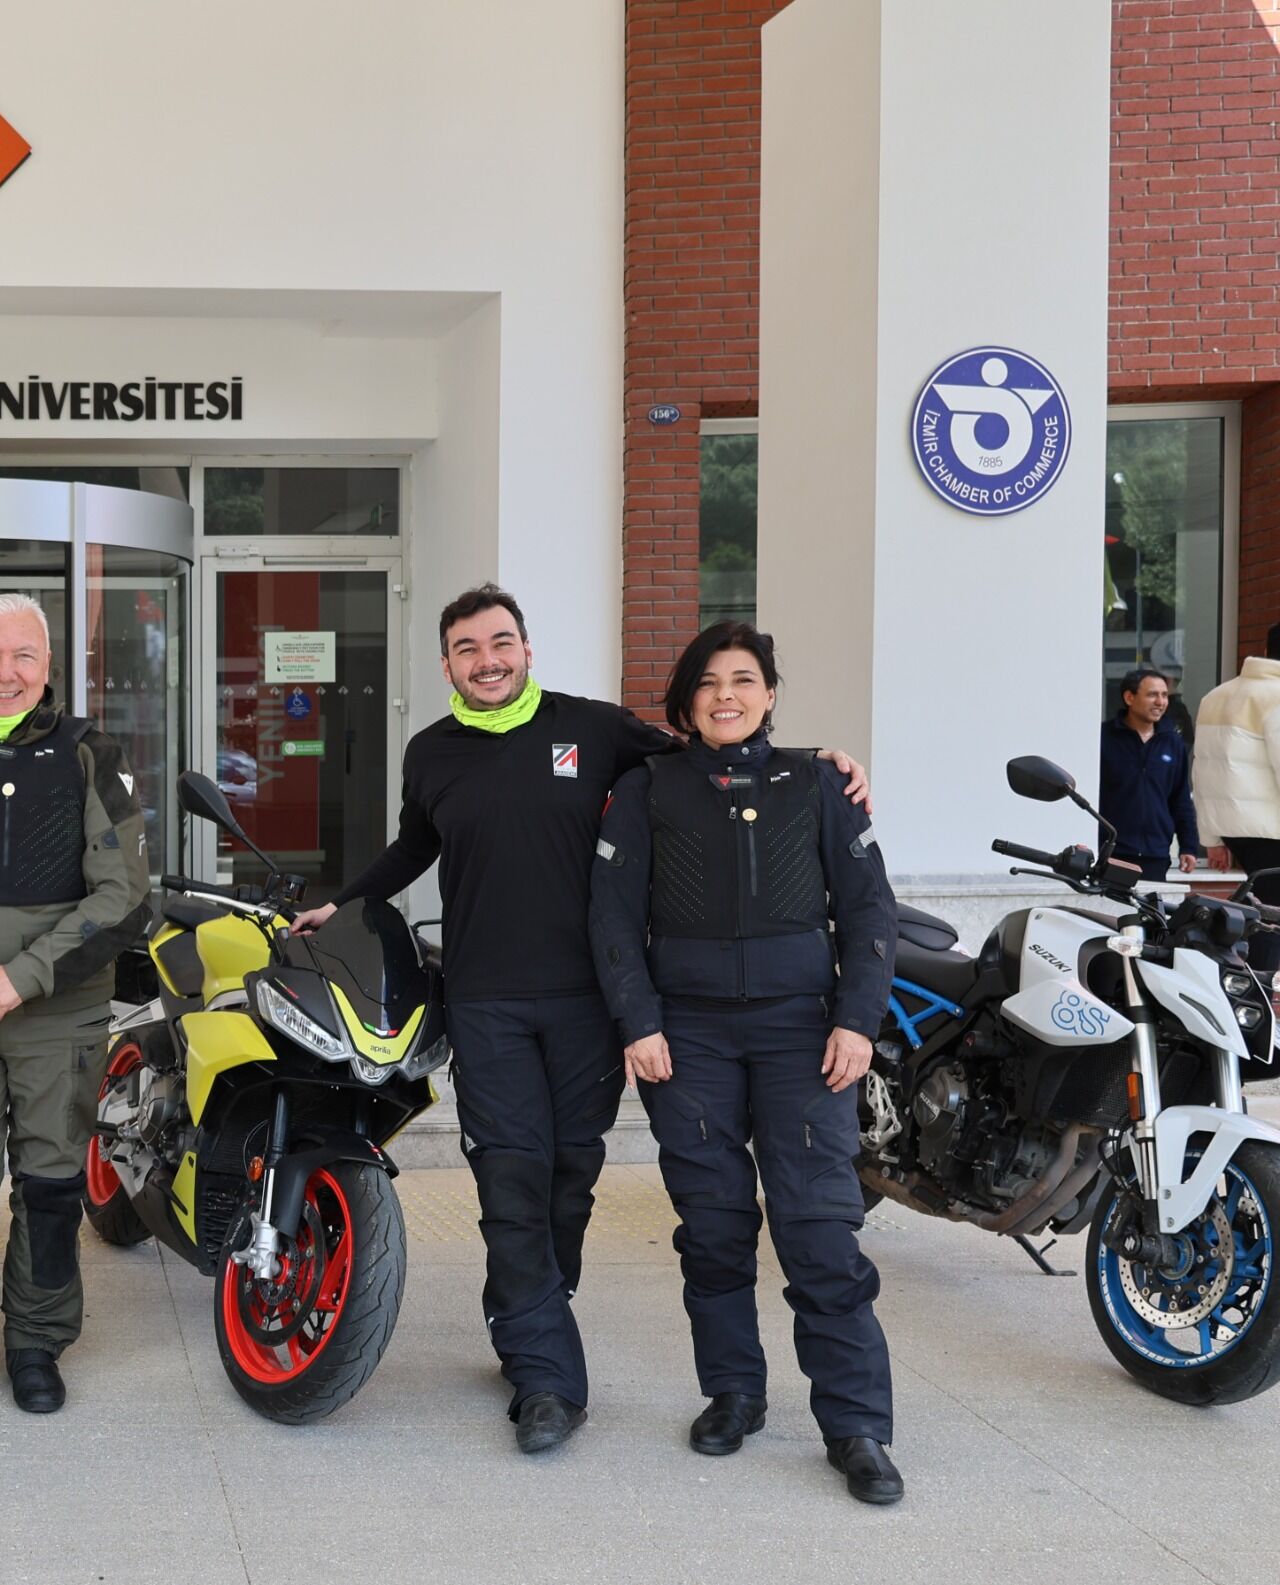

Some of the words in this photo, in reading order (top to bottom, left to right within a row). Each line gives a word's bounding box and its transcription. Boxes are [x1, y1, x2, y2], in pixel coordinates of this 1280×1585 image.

[923, 409, 941, 454] İZMİR
[977, 455, 1003, 469] 1885
[1014, 415, 1059, 496] COMMERCE
[928, 455, 990, 504] CHAMBER
[992, 486, 1013, 504] OF
[1028, 943, 1073, 973] SUZUKI
